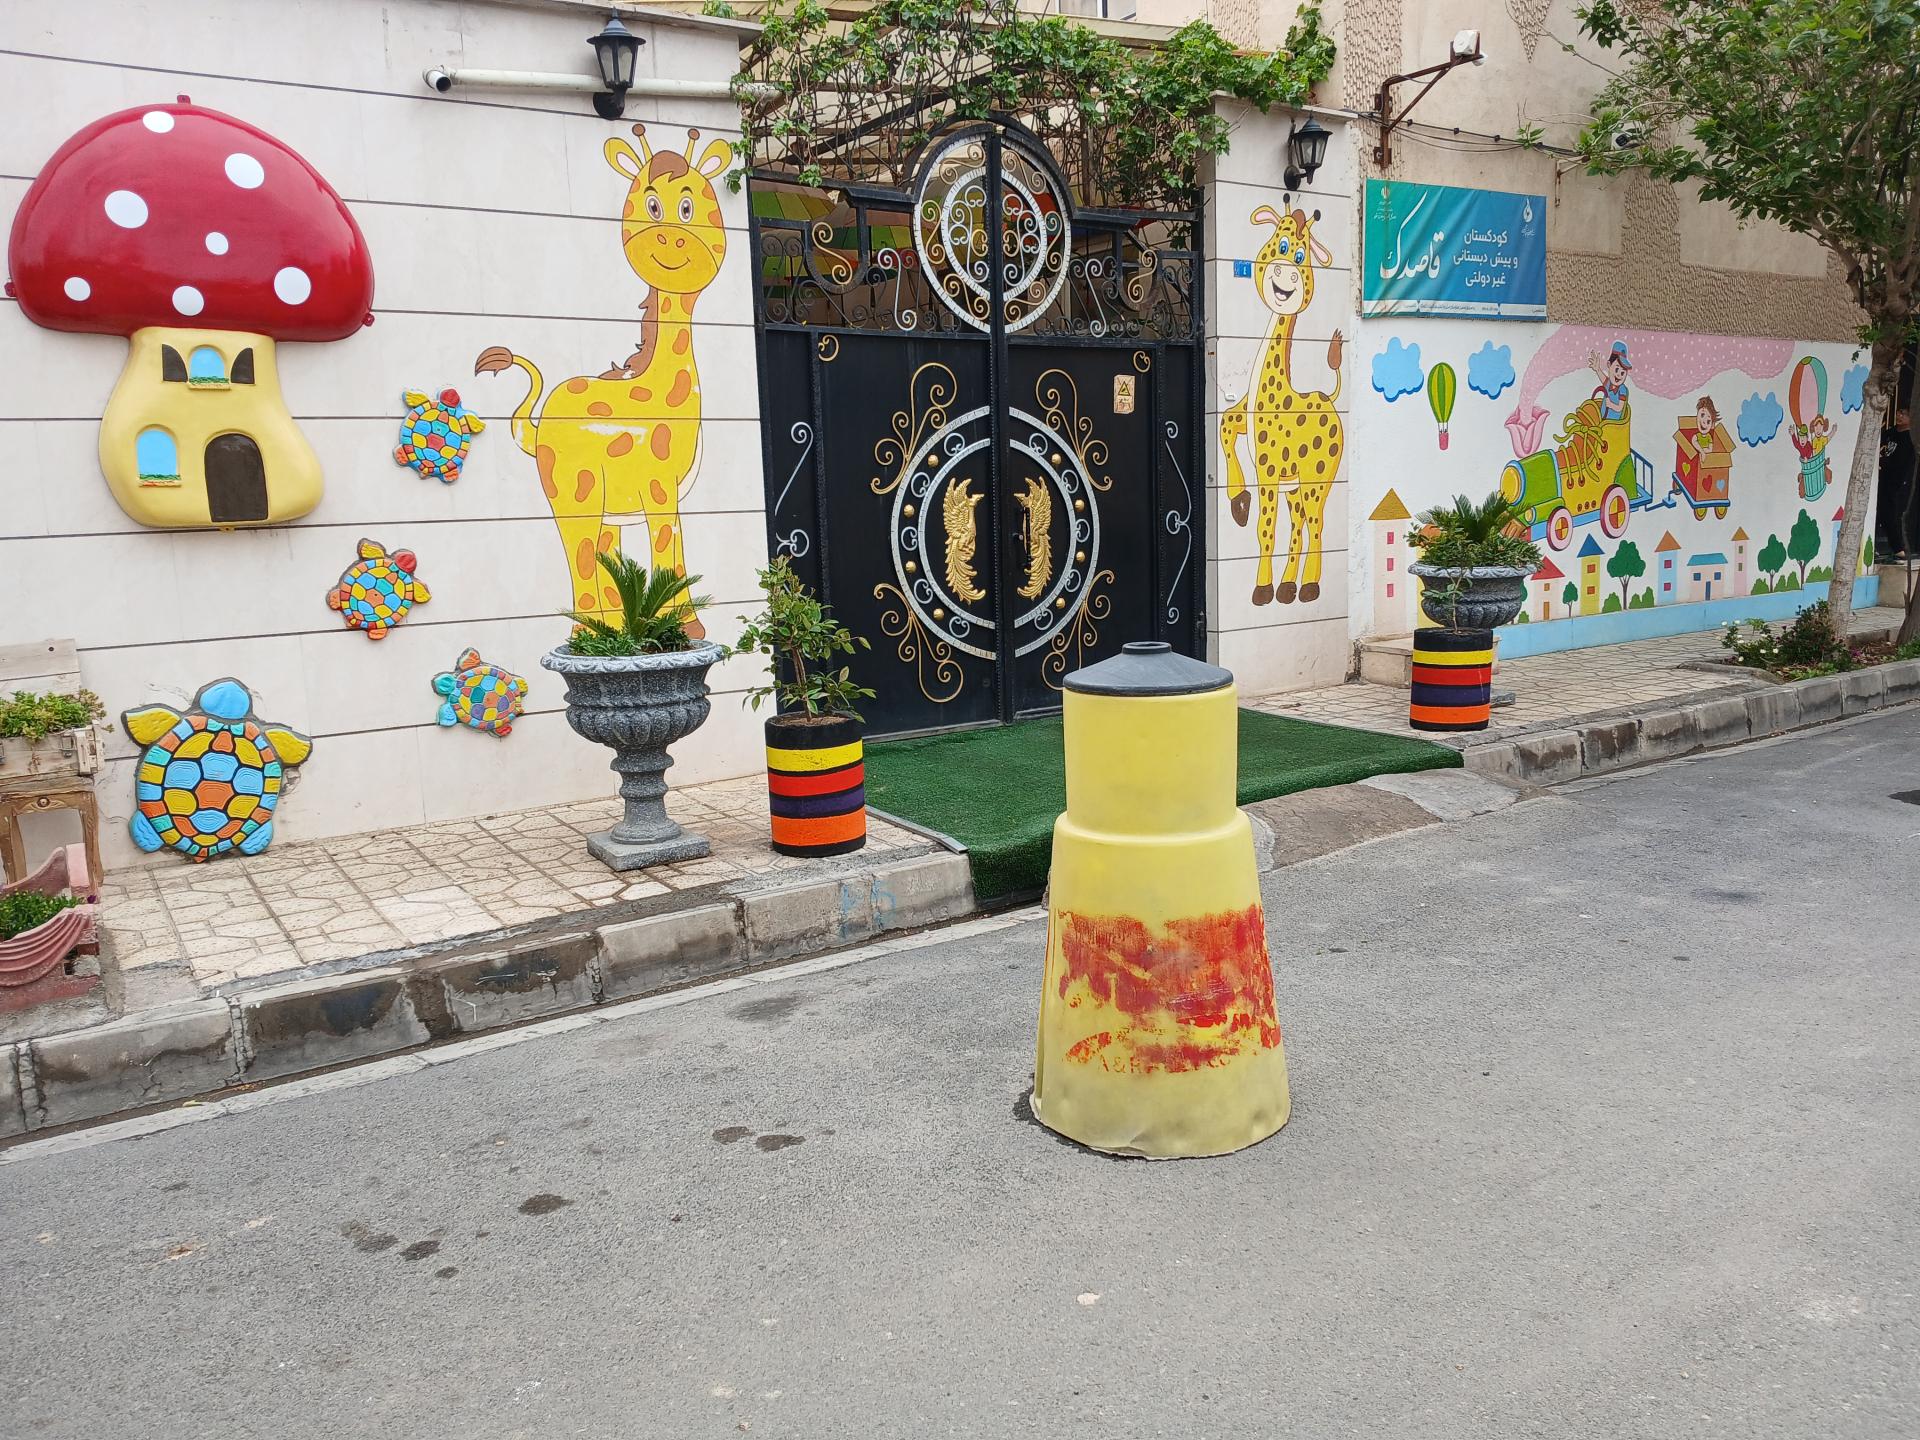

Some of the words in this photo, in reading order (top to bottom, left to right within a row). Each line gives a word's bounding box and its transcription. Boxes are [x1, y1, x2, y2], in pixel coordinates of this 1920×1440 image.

[1380, 189, 1445, 280] قاصدک
[1463, 228, 1508, 248] کودکستان
[1453, 249, 1488, 266] دبستانی
[1489, 251, 1512, 269] پیش
[1512, 256, 1519, 269] و
[1465, 271, 1491, 288] دولتی
[1491, 272, 1506, 288] غیر
